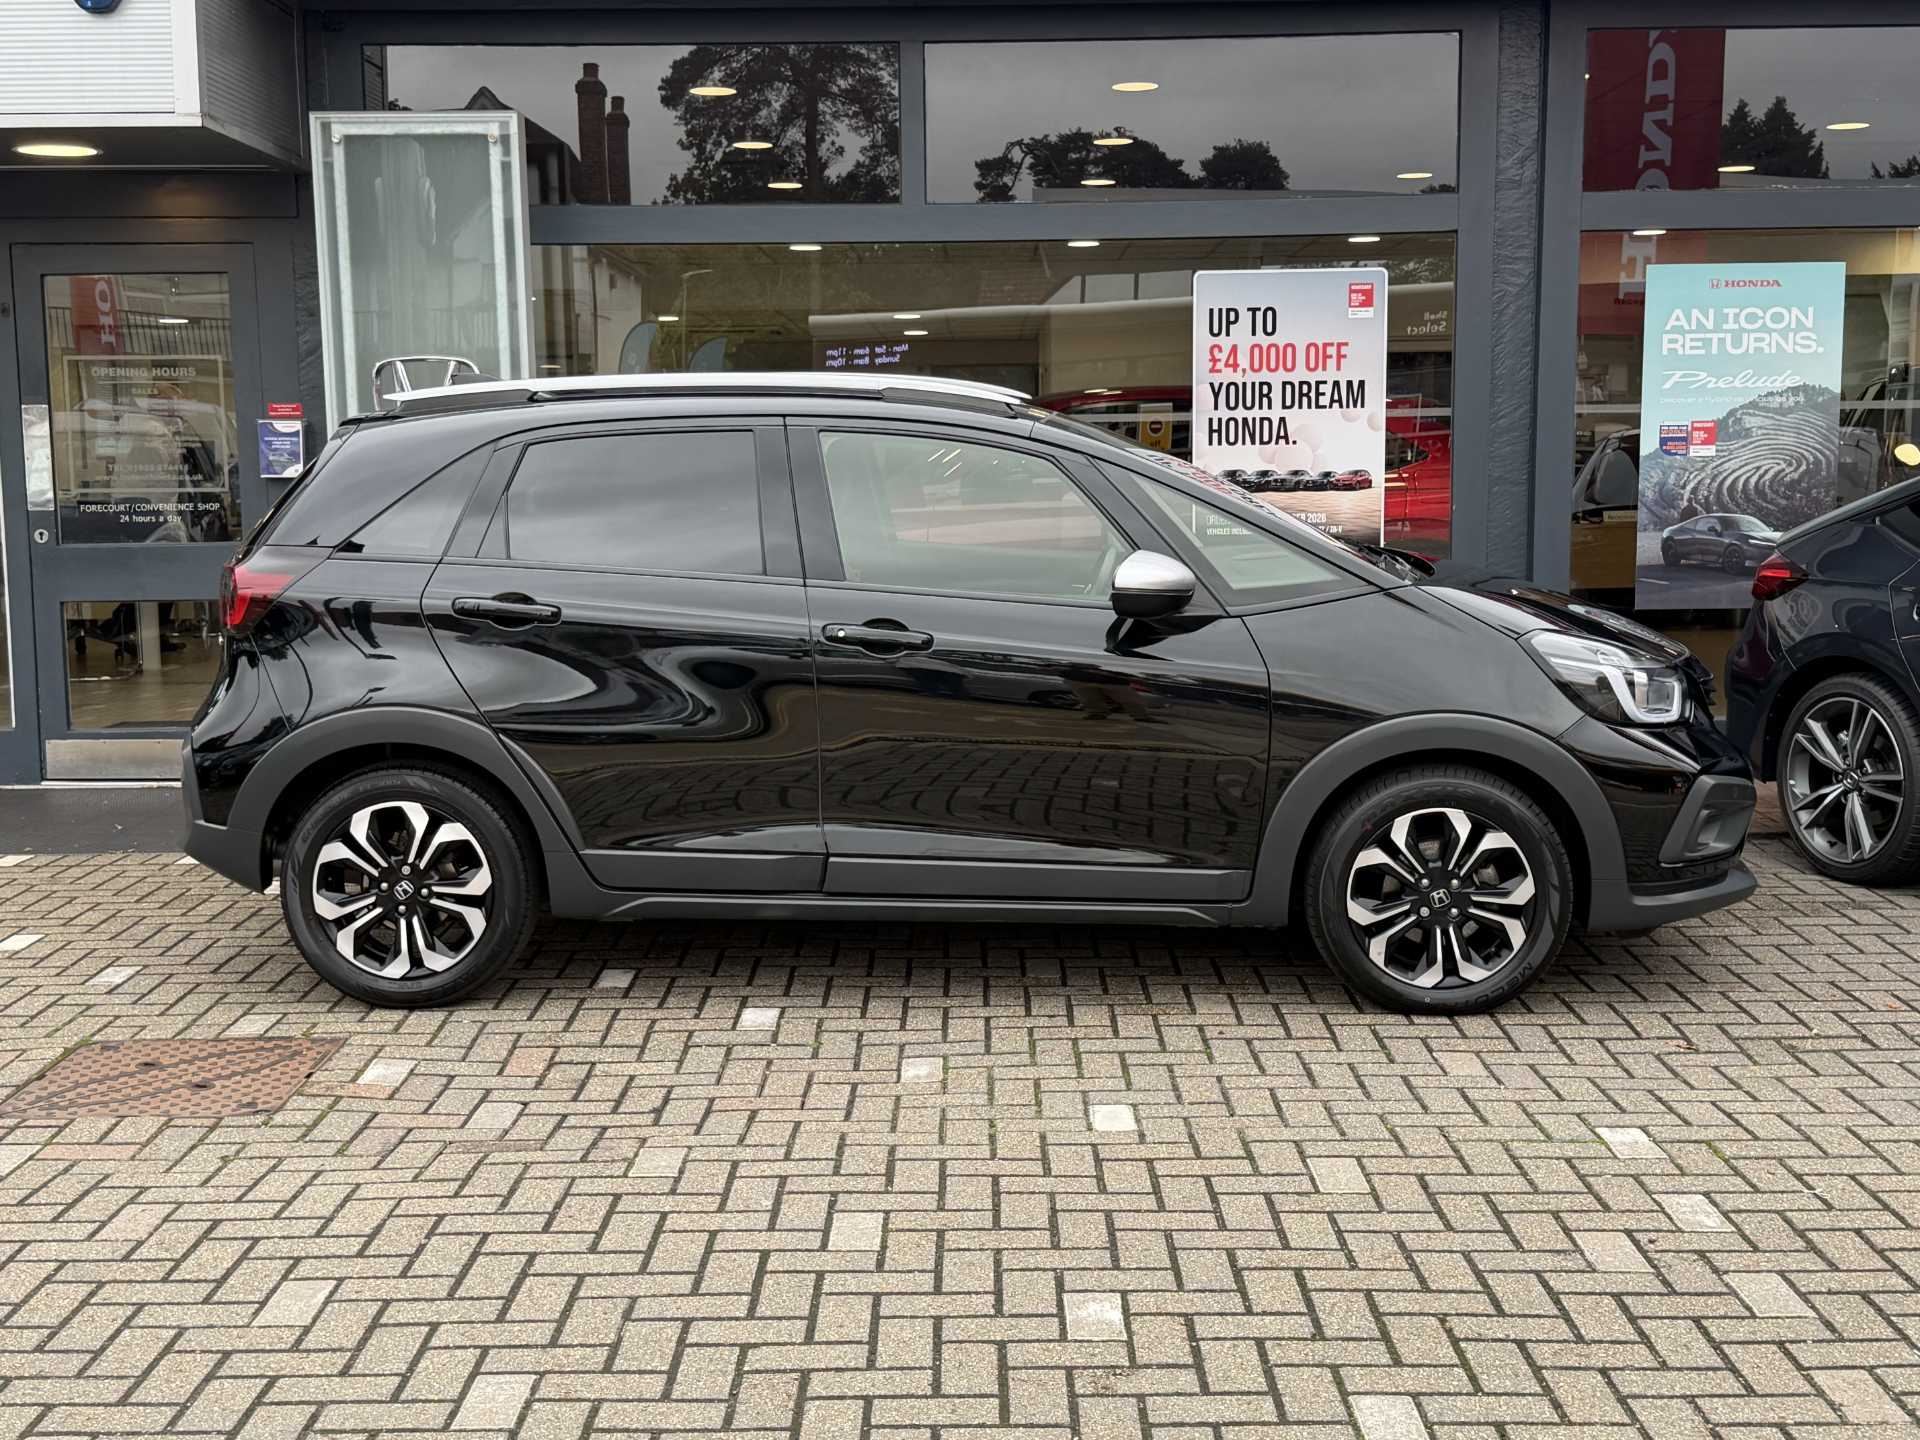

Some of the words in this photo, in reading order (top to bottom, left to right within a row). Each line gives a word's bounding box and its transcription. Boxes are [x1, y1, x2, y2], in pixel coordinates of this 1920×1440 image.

[1724, 279, 1782, 288] HONDA
[1208, 308, 1240, 337] UP
[1247, 306, 1277, 337] TO
[1664, 308, 1714, 330] AN
[1723, 306, 1814, 330] ICON
[1662, 332, 1825, 356] RETURNS.
[91, 367, 148, 377] OPENING
[152, 366, 197, 377] HOURS
[1208, 343, 1297, 377] £4,000
[1305, 342, 1349, 372] OFF
[1662, 370, 1804, 391] Prelude
[1209, 381, 1273, 411] YOUR
[1281, 380, 1366, 410] DREAM
[1208, 416, 1298, 447] HONDA.
[80, 503, 195, 512] FORECOURT/CONVENIENCE
[197, 502, 220, 511] SHOP
[120, 515, 130, 523] 24
[133, 514, 156, 522] hours
[167, 514, 182, 523] day
